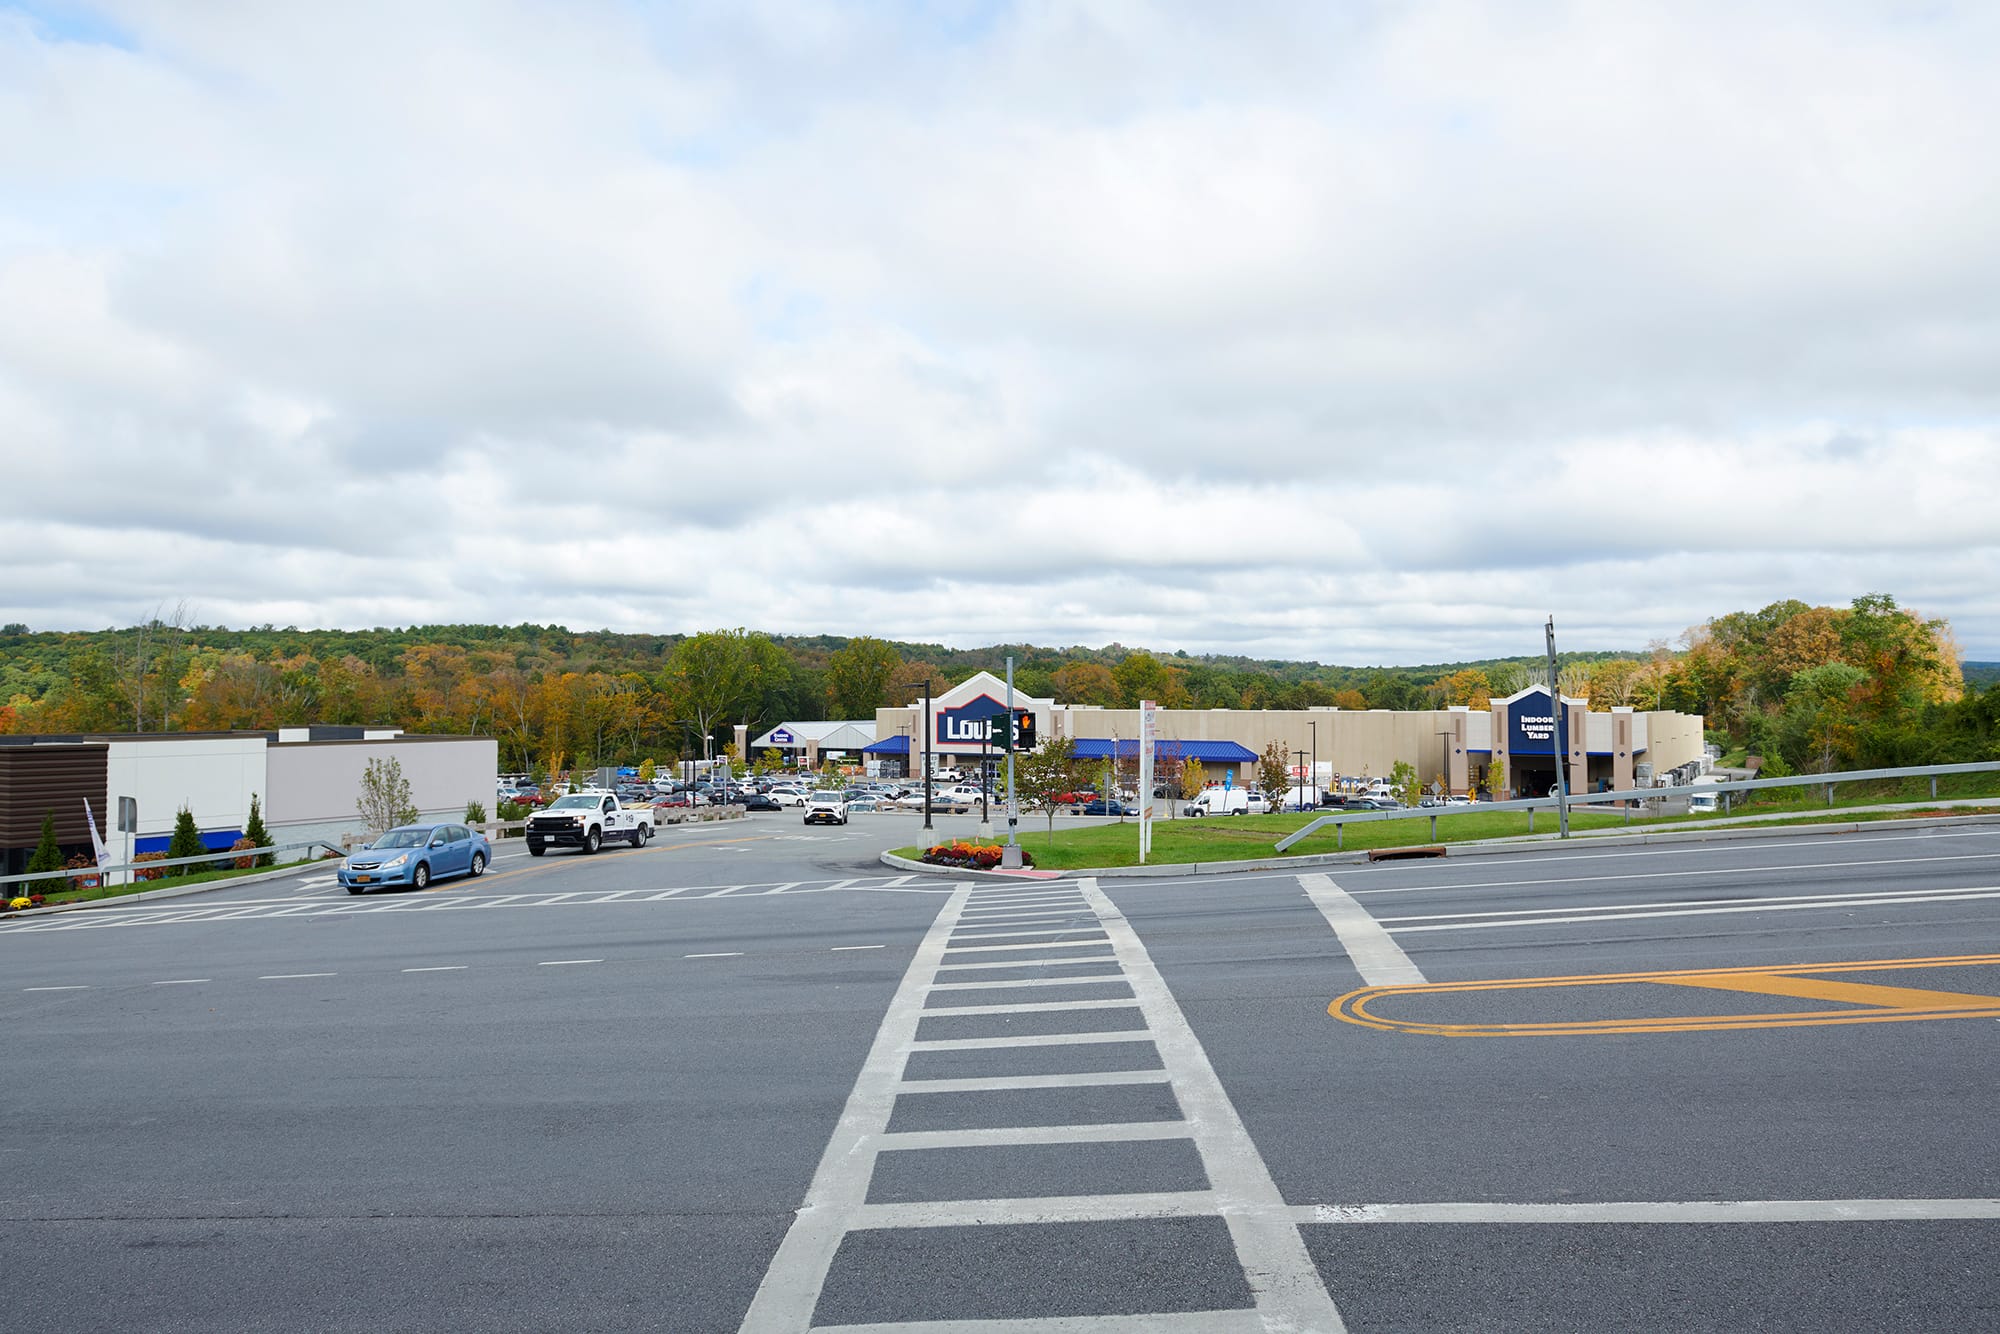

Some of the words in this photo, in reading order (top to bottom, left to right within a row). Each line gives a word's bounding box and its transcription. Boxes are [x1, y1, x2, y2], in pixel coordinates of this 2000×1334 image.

[1521, 715, 1554, 723] INDOOR
[947, 716, 1020, 740] LOWS
[1521, 723, 1554, 732] LUMBER
[1526, 731, 1550, 739] YARD
